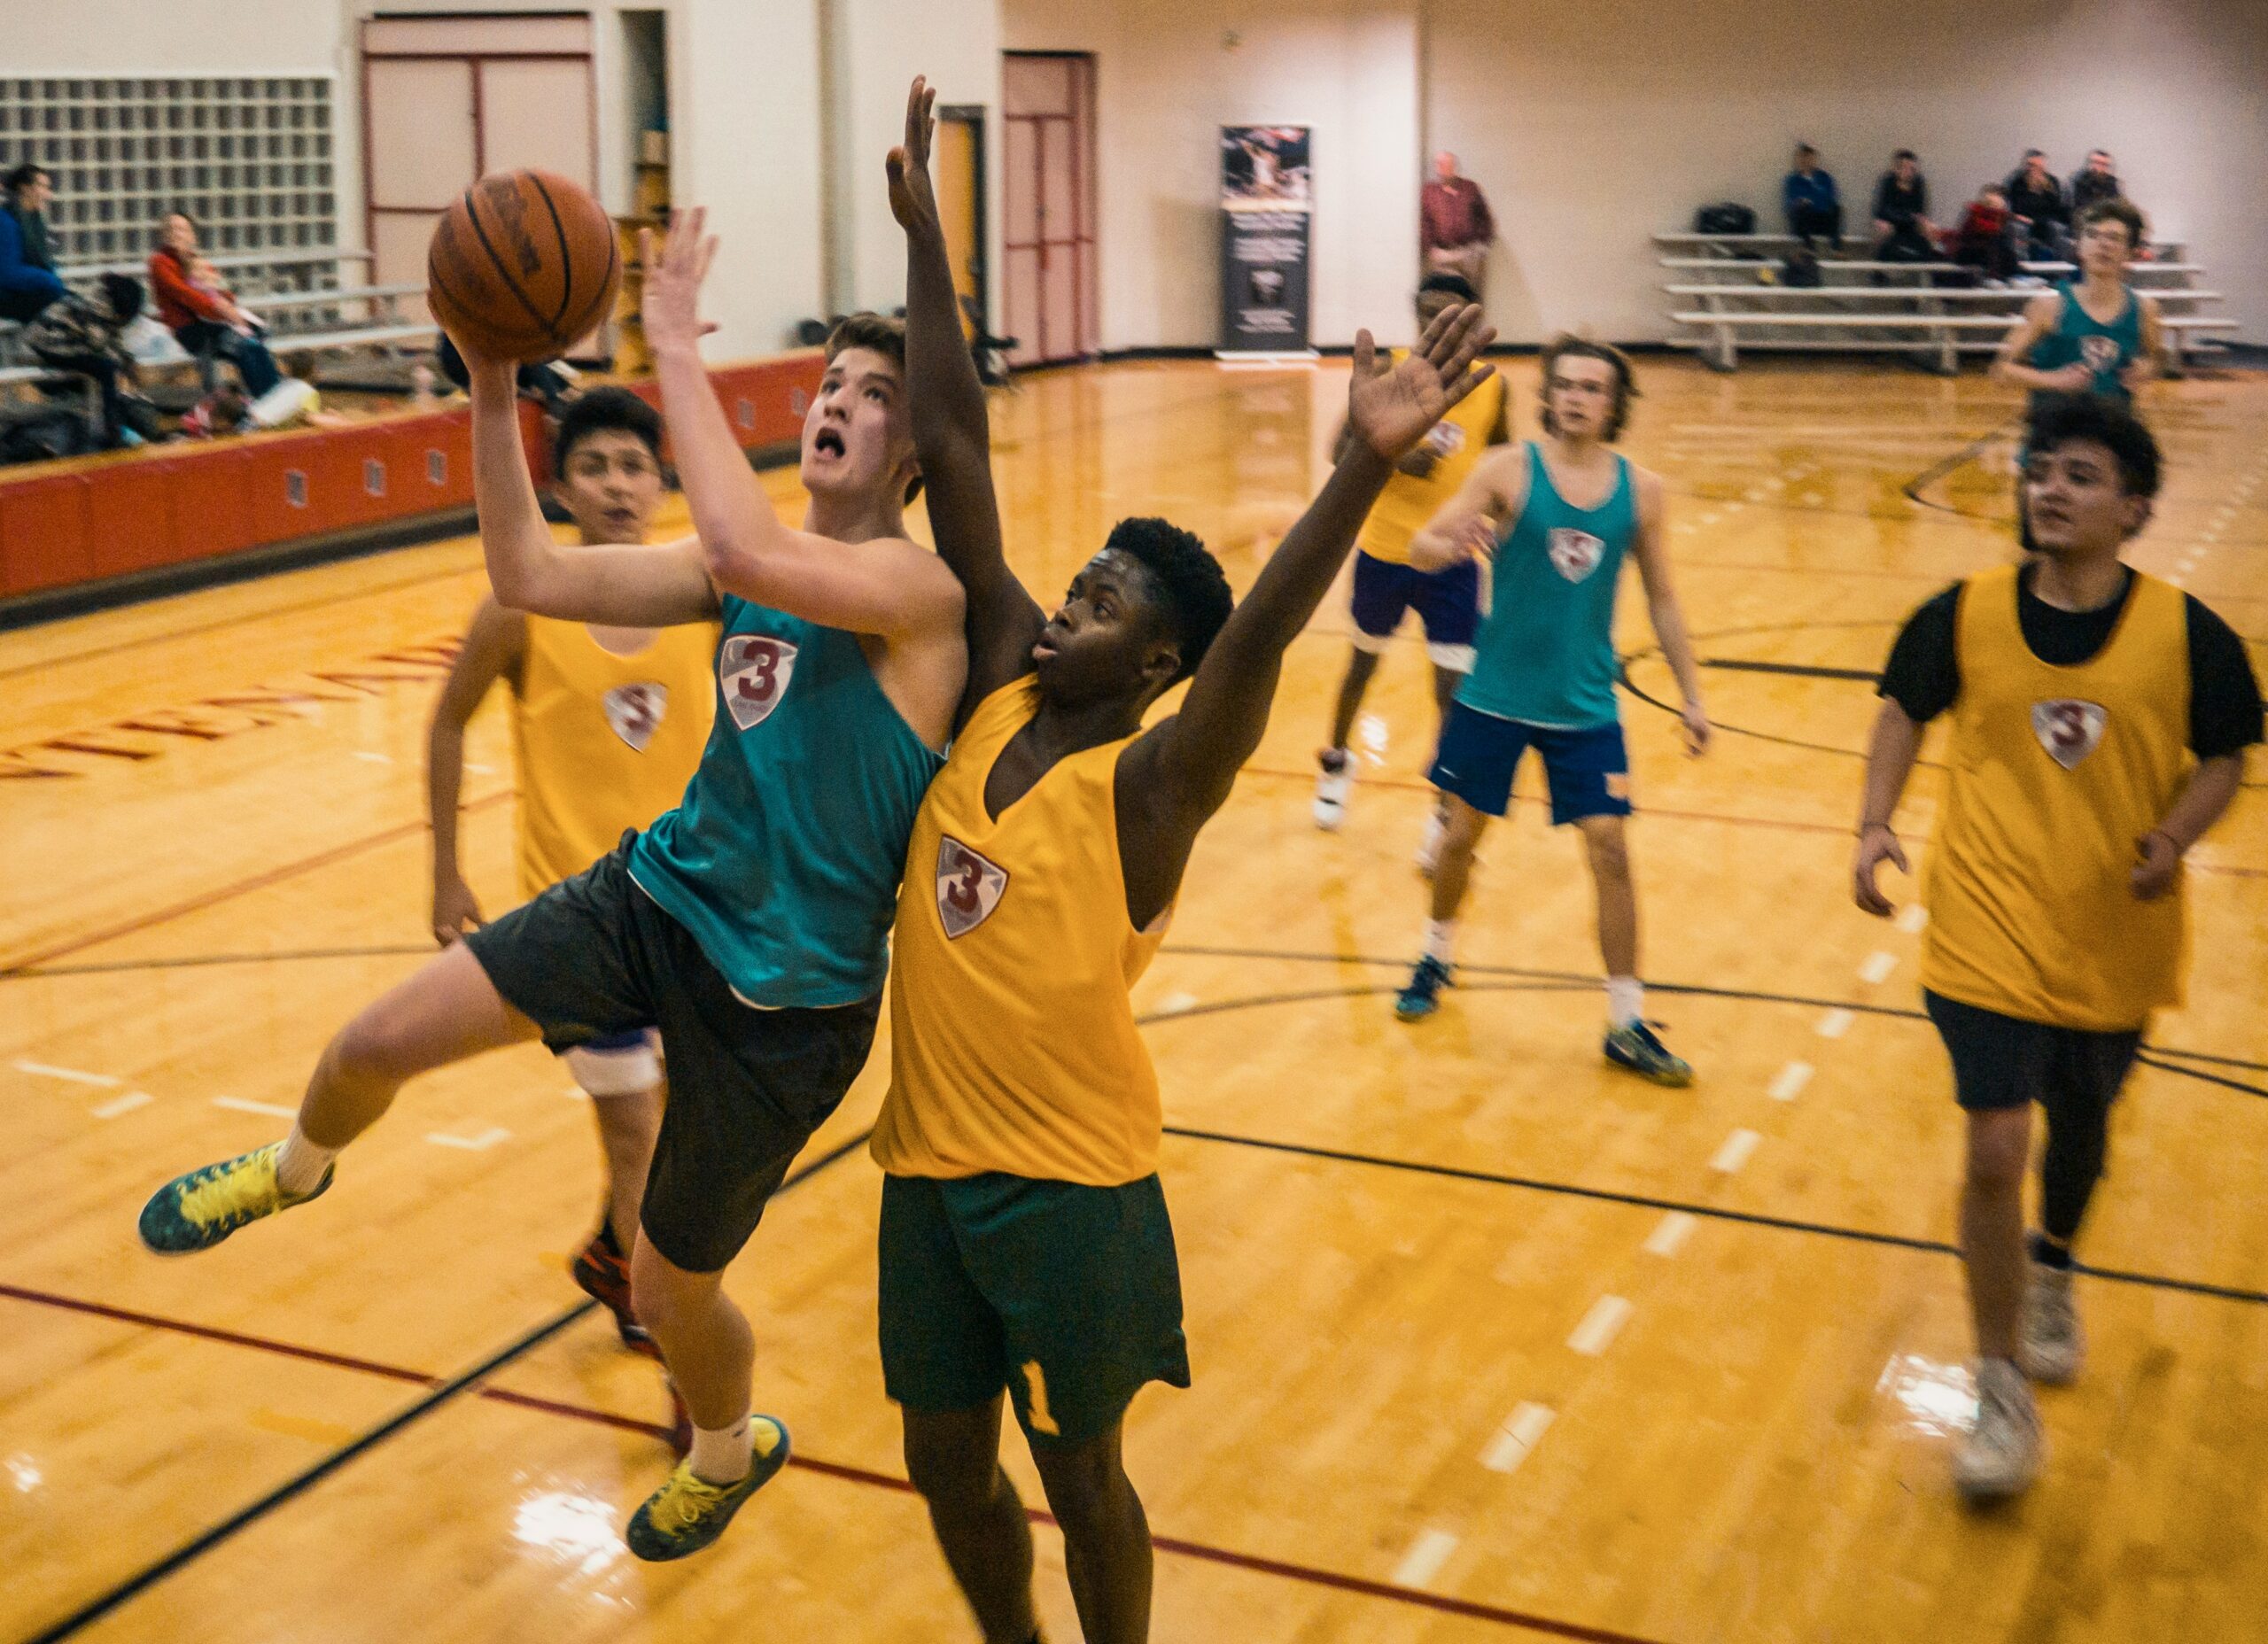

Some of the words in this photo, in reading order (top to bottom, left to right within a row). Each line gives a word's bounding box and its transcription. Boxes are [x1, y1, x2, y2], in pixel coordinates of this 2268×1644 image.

[738, 640, 780, 701] 3
[947, 850, 983, 914] 3
[1021, 1359, 1060, 1436] 1
